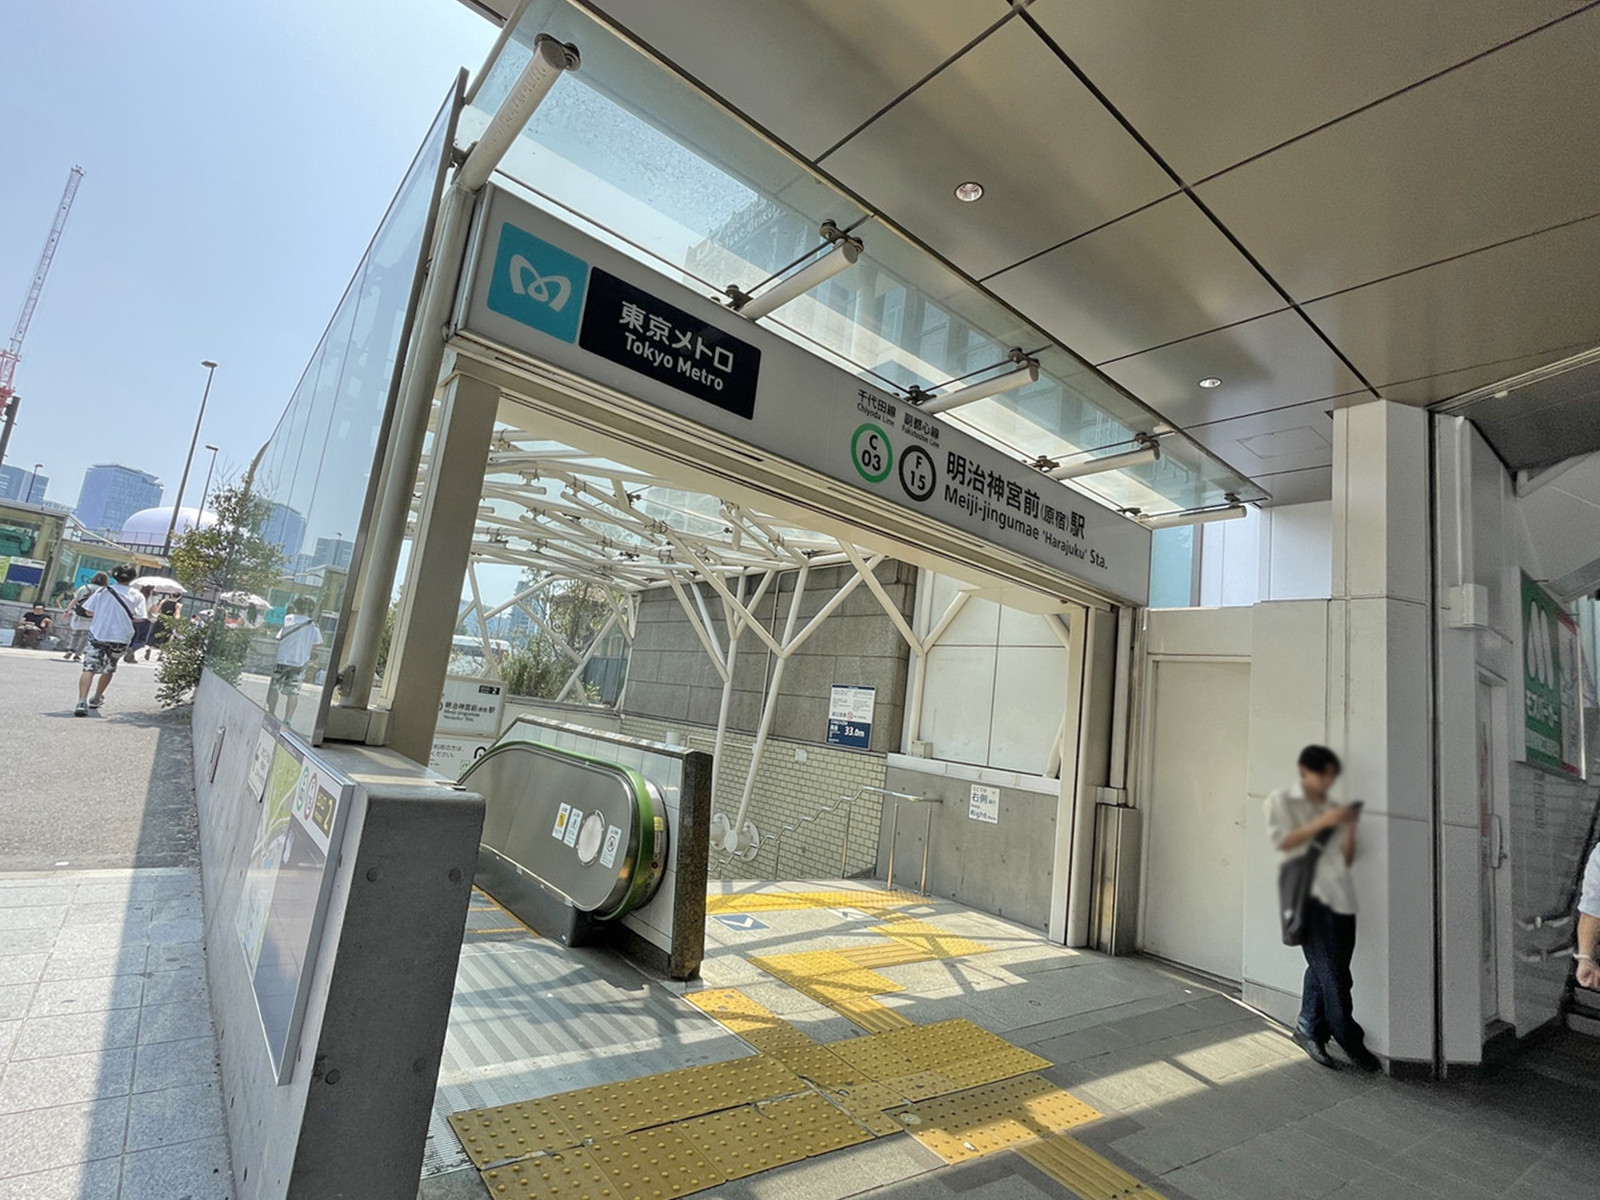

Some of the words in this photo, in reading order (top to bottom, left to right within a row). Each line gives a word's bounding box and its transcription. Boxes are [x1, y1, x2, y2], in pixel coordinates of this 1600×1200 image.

[618, 300, 734, 374] 東京メトロ
[624, 331, 674, 368] Tokyo
[676, 356, 724, 391] Metro
[857, 402, 882, 420] Chiyoda
[882, 415, 895, 427] Line
[858, 389, 897, 418] 千代田線
[904, 412, 940, 440] 副都心線
[869, 434, 879, 451] C
[861, 449, 881, 472] 03
[915, 455, 923, 469] F
[910, 470, 926, 491] 15
[944, 484, 1040, 541] Meiji-jingumae
[1089, 549, 1108, 570] Sta.
[844, 725, 866, 738] 33.0m
